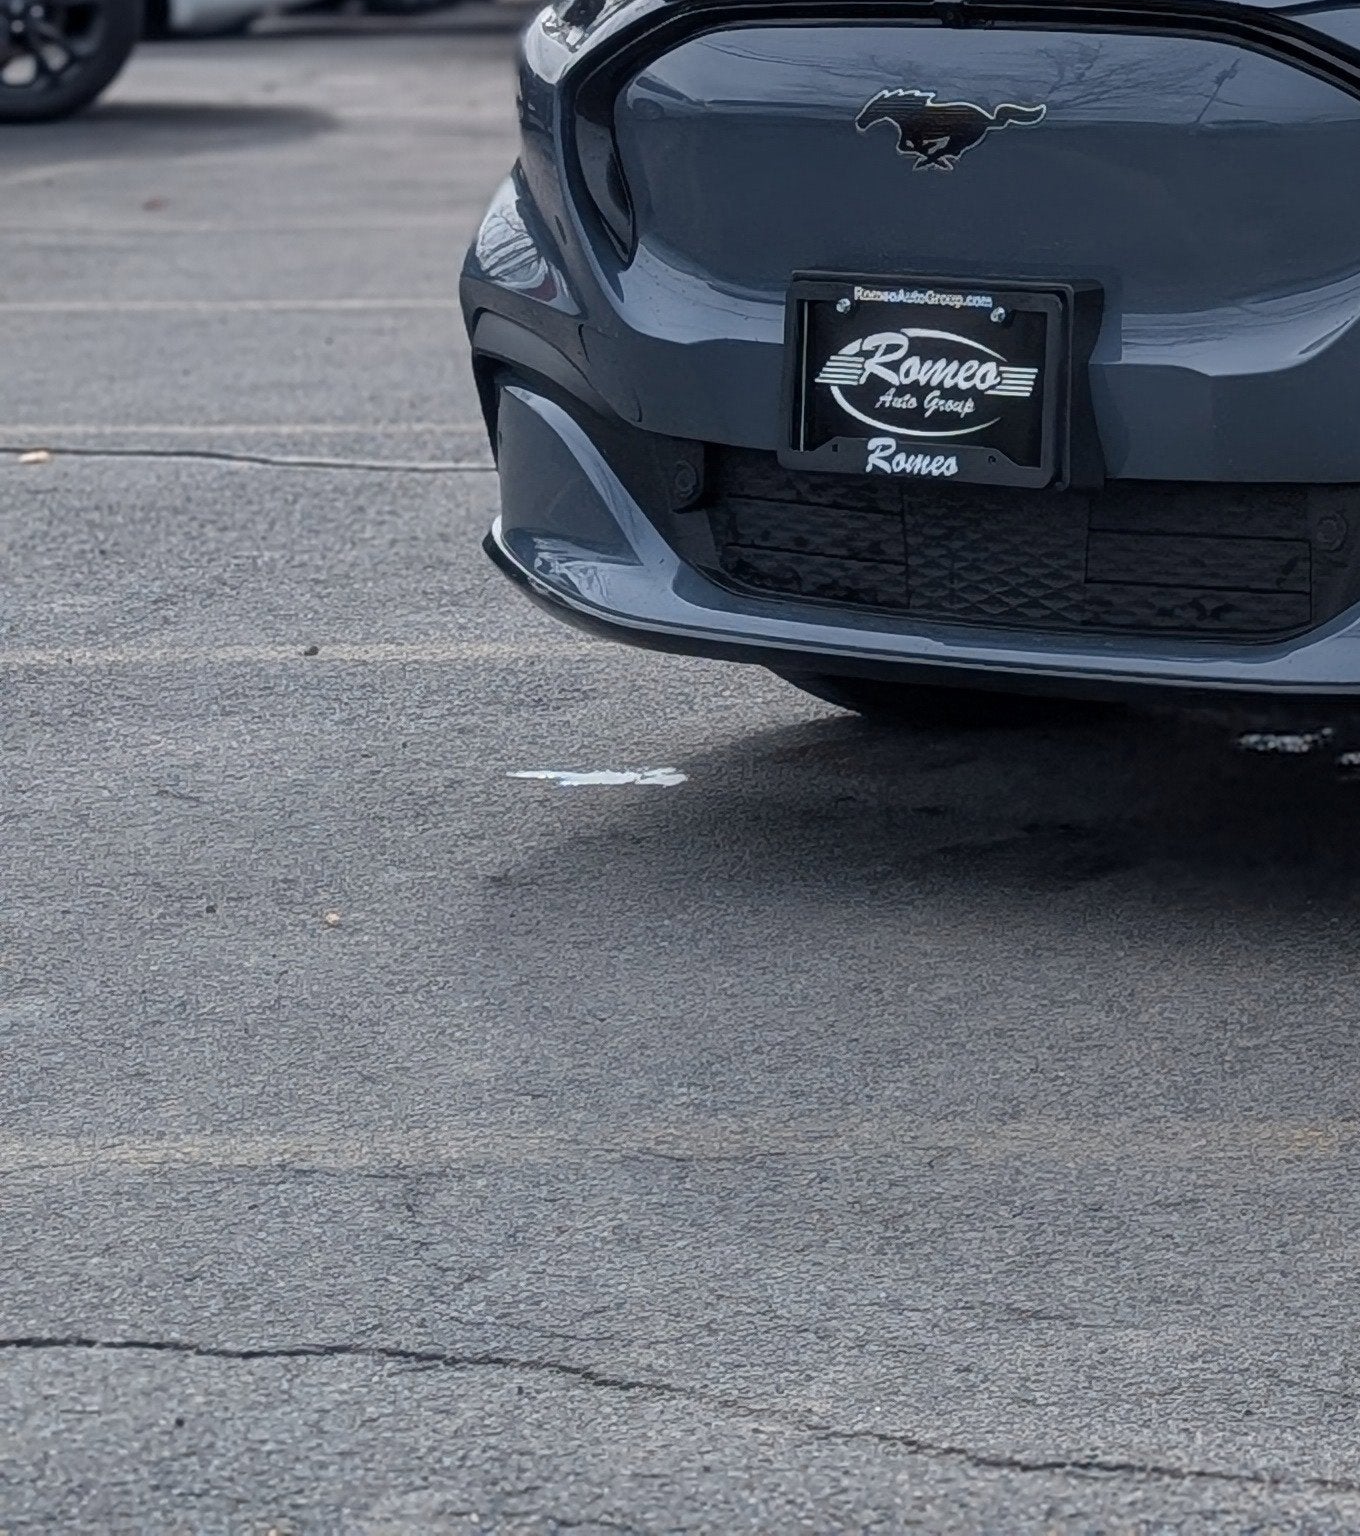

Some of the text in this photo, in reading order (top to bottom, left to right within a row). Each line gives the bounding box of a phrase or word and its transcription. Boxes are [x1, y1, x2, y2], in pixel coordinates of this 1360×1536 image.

[859, 332, 1000, 390] Romeo
[875, 388, 976, 417] Auto Group
[865, 437, 959, 476] Romeo
